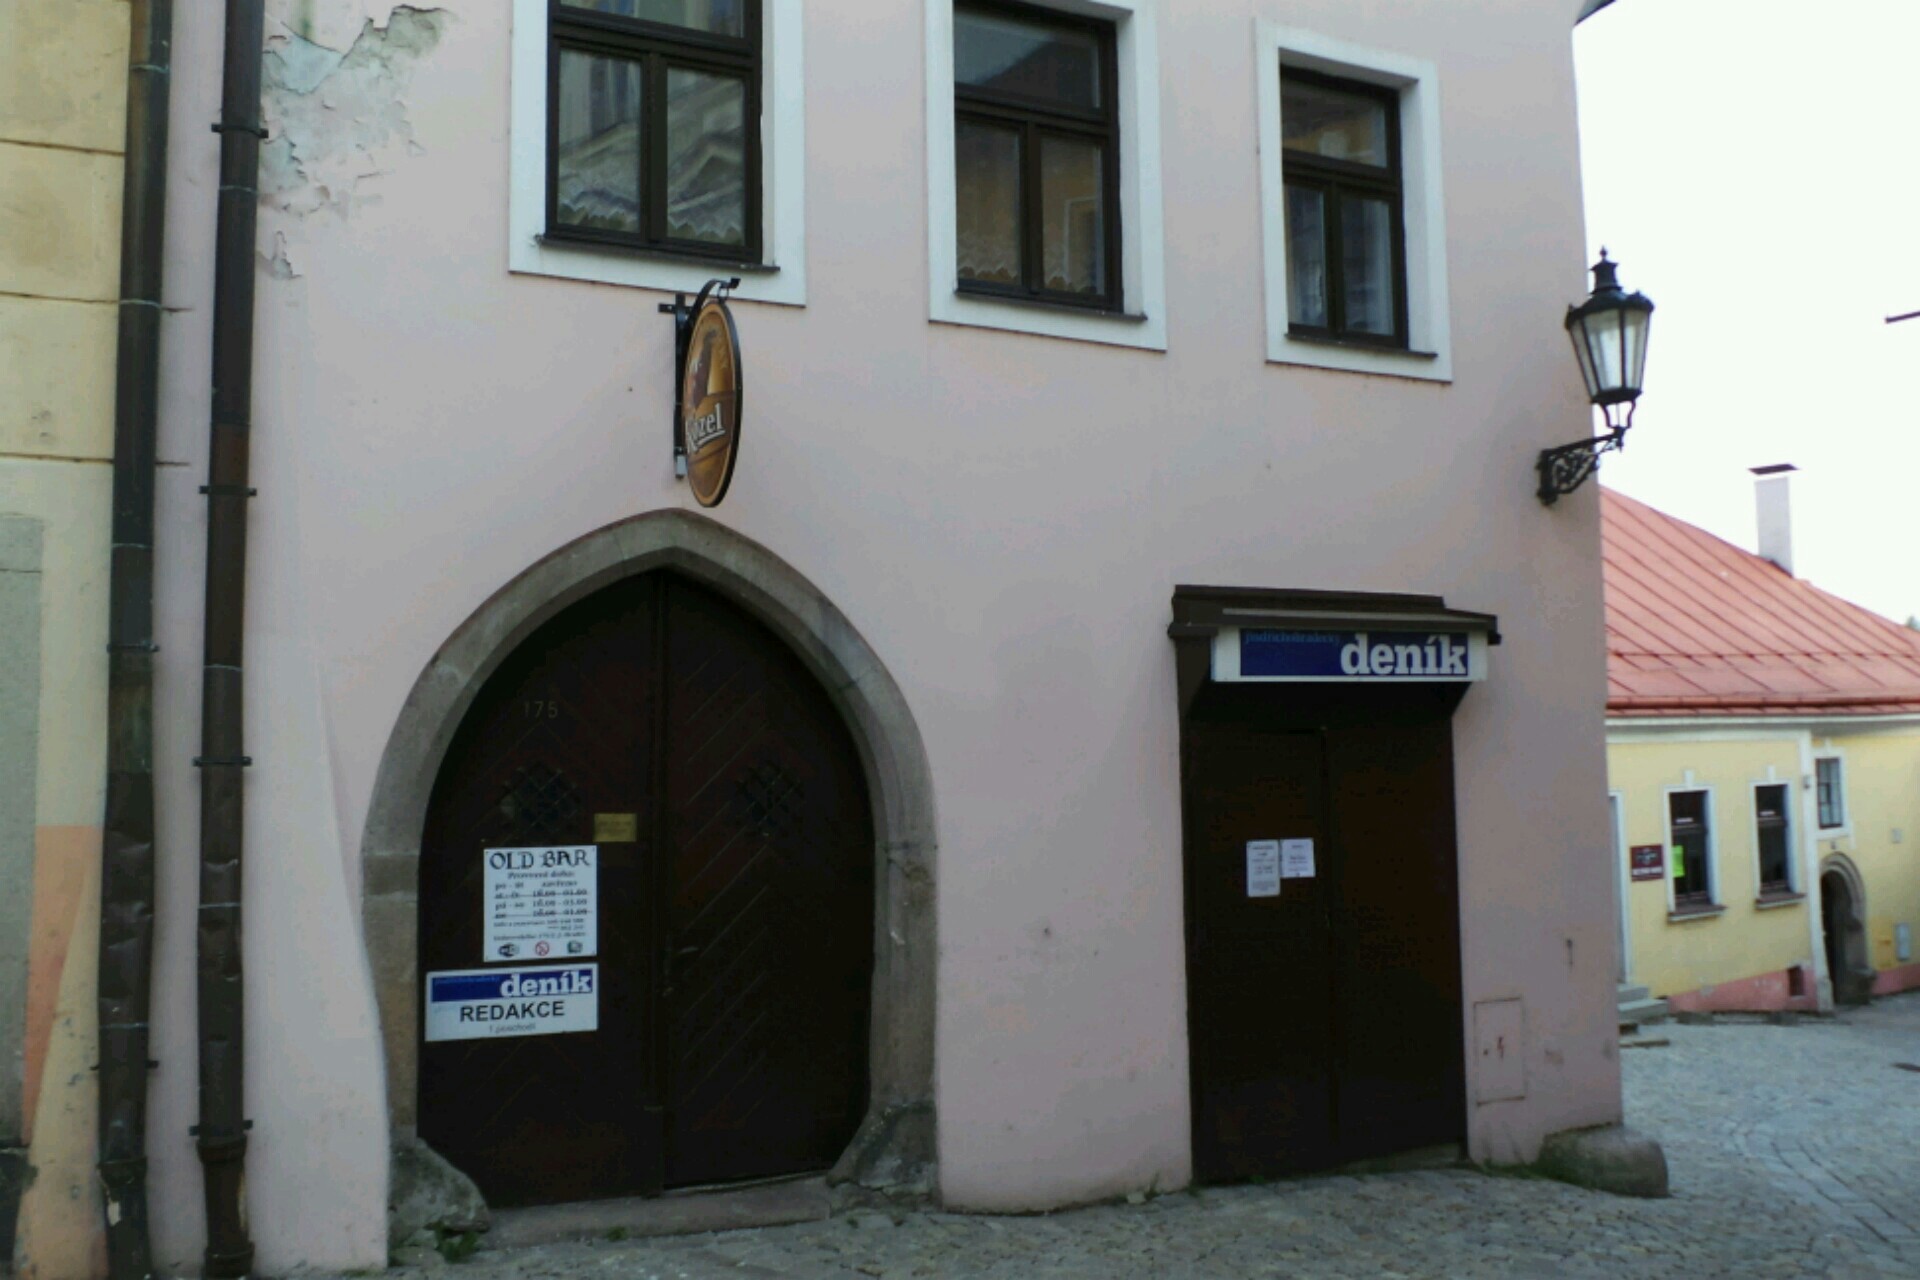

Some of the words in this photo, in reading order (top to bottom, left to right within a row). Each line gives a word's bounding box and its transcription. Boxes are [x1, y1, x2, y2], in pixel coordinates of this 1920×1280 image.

[1340, 632, 1467, 676] deník
[489, 852, 534, 870] OLD
[540, 849, 591, 869] BAR
[500, 969, 593, 998] deník
[459, 1001, 566, 1022] REDAKCE
